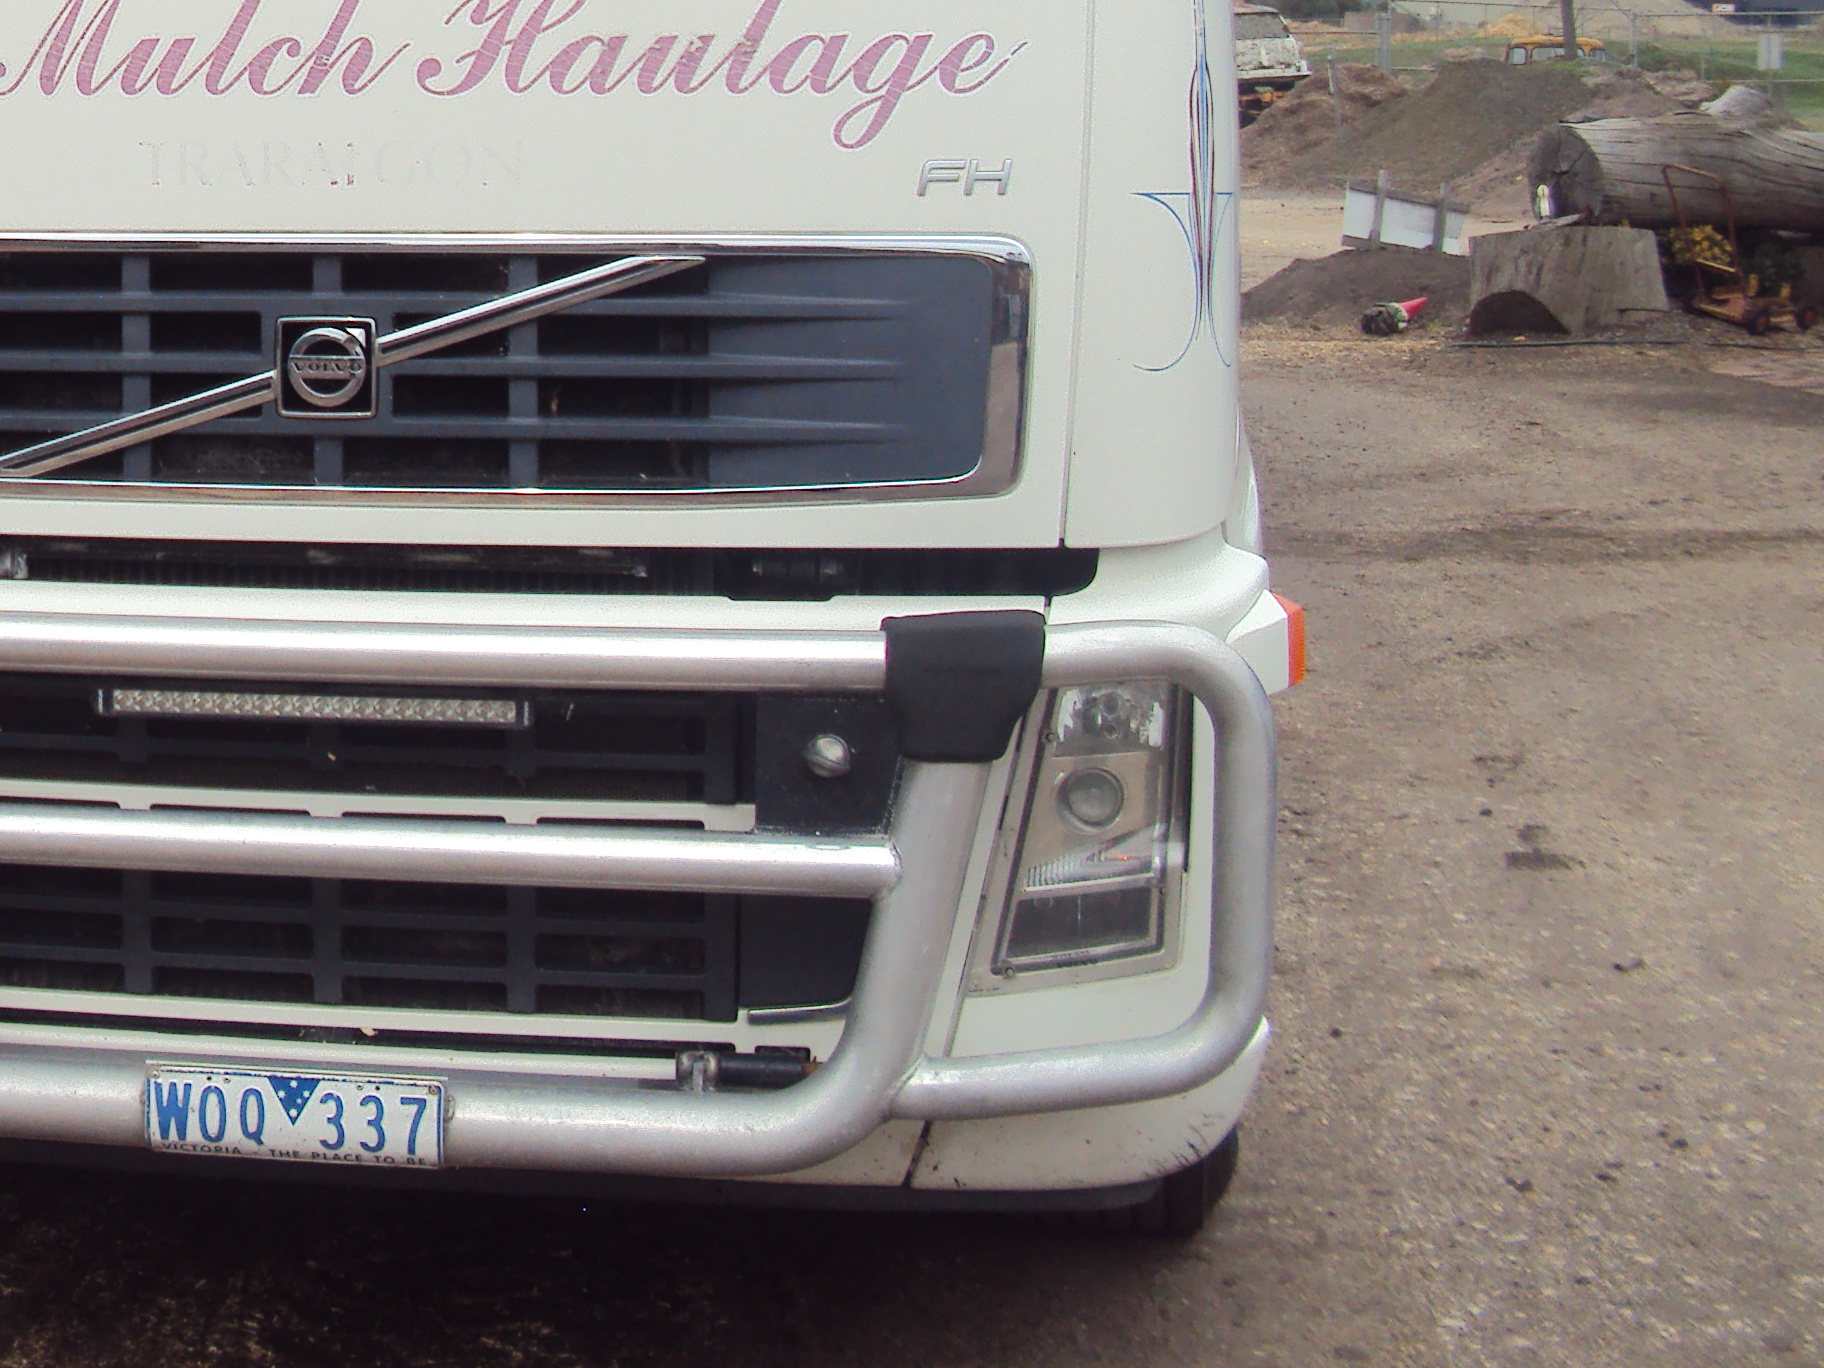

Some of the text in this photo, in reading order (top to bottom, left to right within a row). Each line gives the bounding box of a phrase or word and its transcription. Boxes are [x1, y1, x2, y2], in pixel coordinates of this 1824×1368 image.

[916, 158, 1013, 197] FH
[291, 361, 363, 374] VOLVO
[154, 1082, 427, 1156] WOQ 337
[161, 1142, 242, 1155] VICTORIA
[311, 1151, 362, 1162] PLACE
[374, 1155, 396, 1164] TO
